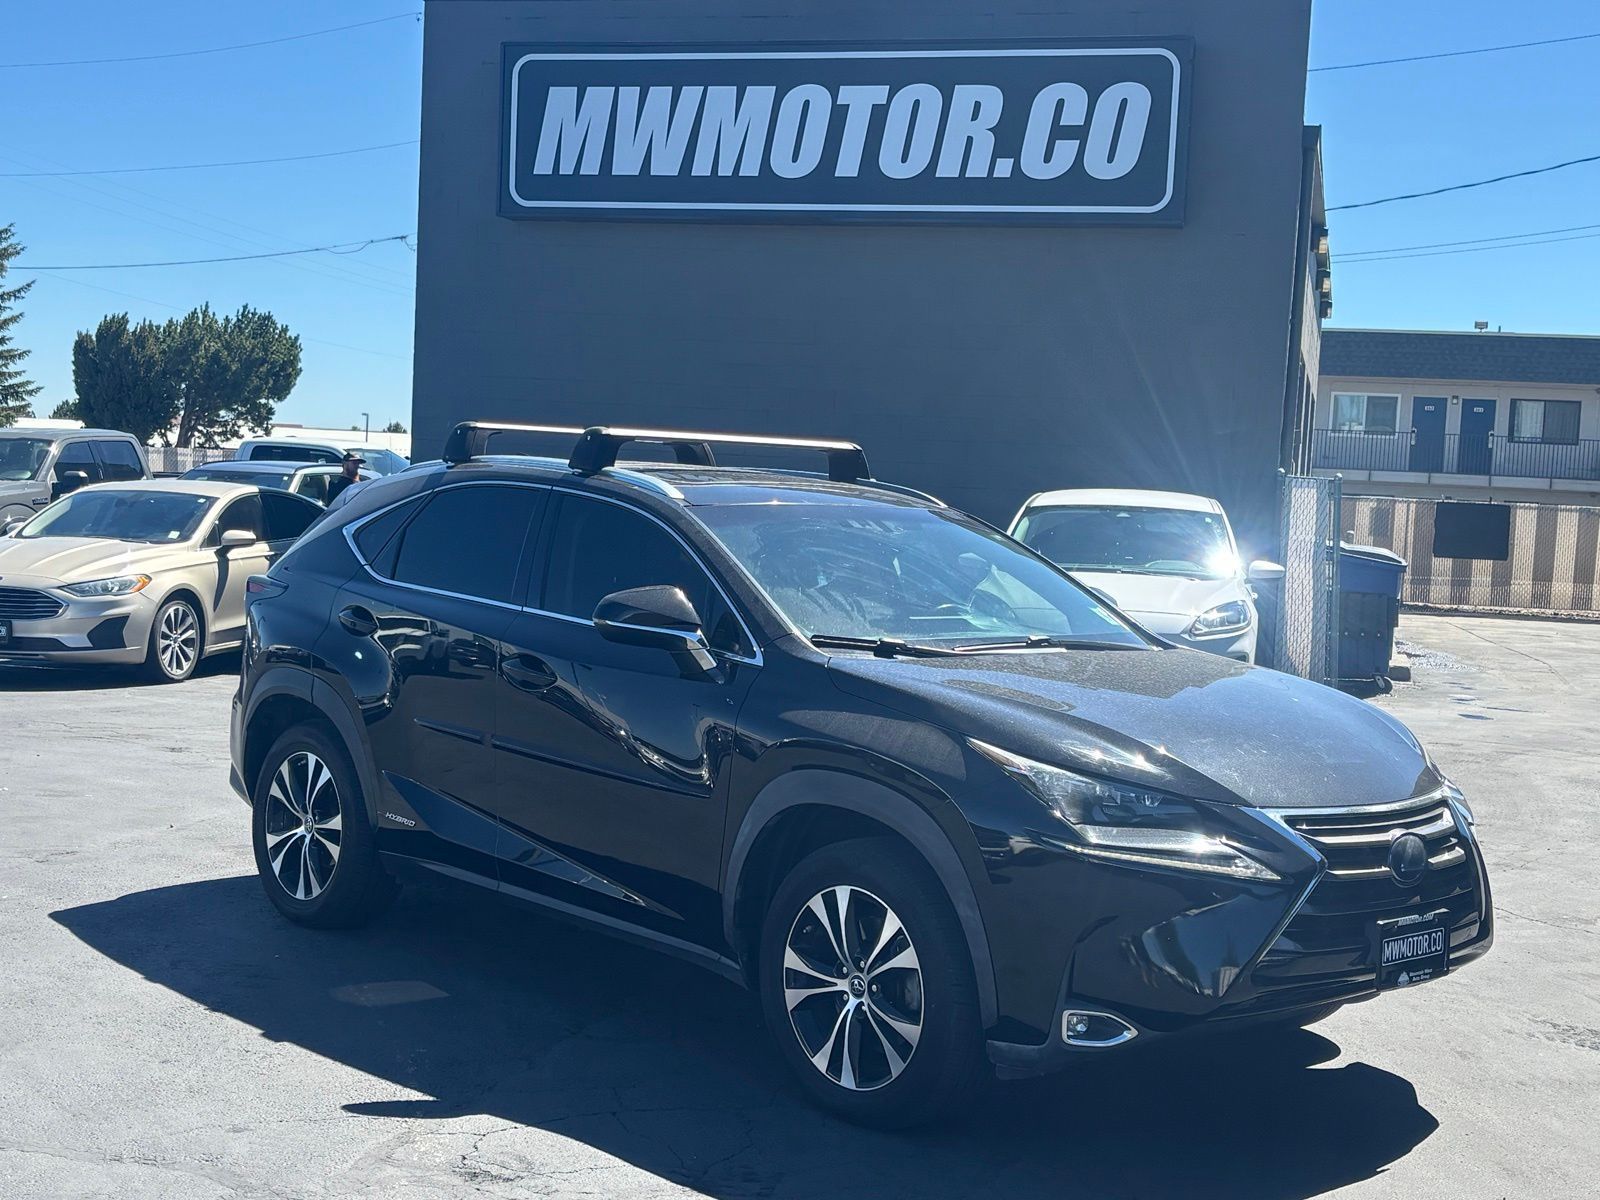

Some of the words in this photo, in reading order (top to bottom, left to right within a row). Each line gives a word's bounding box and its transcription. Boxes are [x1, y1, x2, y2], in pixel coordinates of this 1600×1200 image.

[533, 81, 1152, 180] MWMOTOR.CO
[385, 811, 416, 827] HYBRID
[1384, 931, 1442, 962] MWMOTOR.CO
